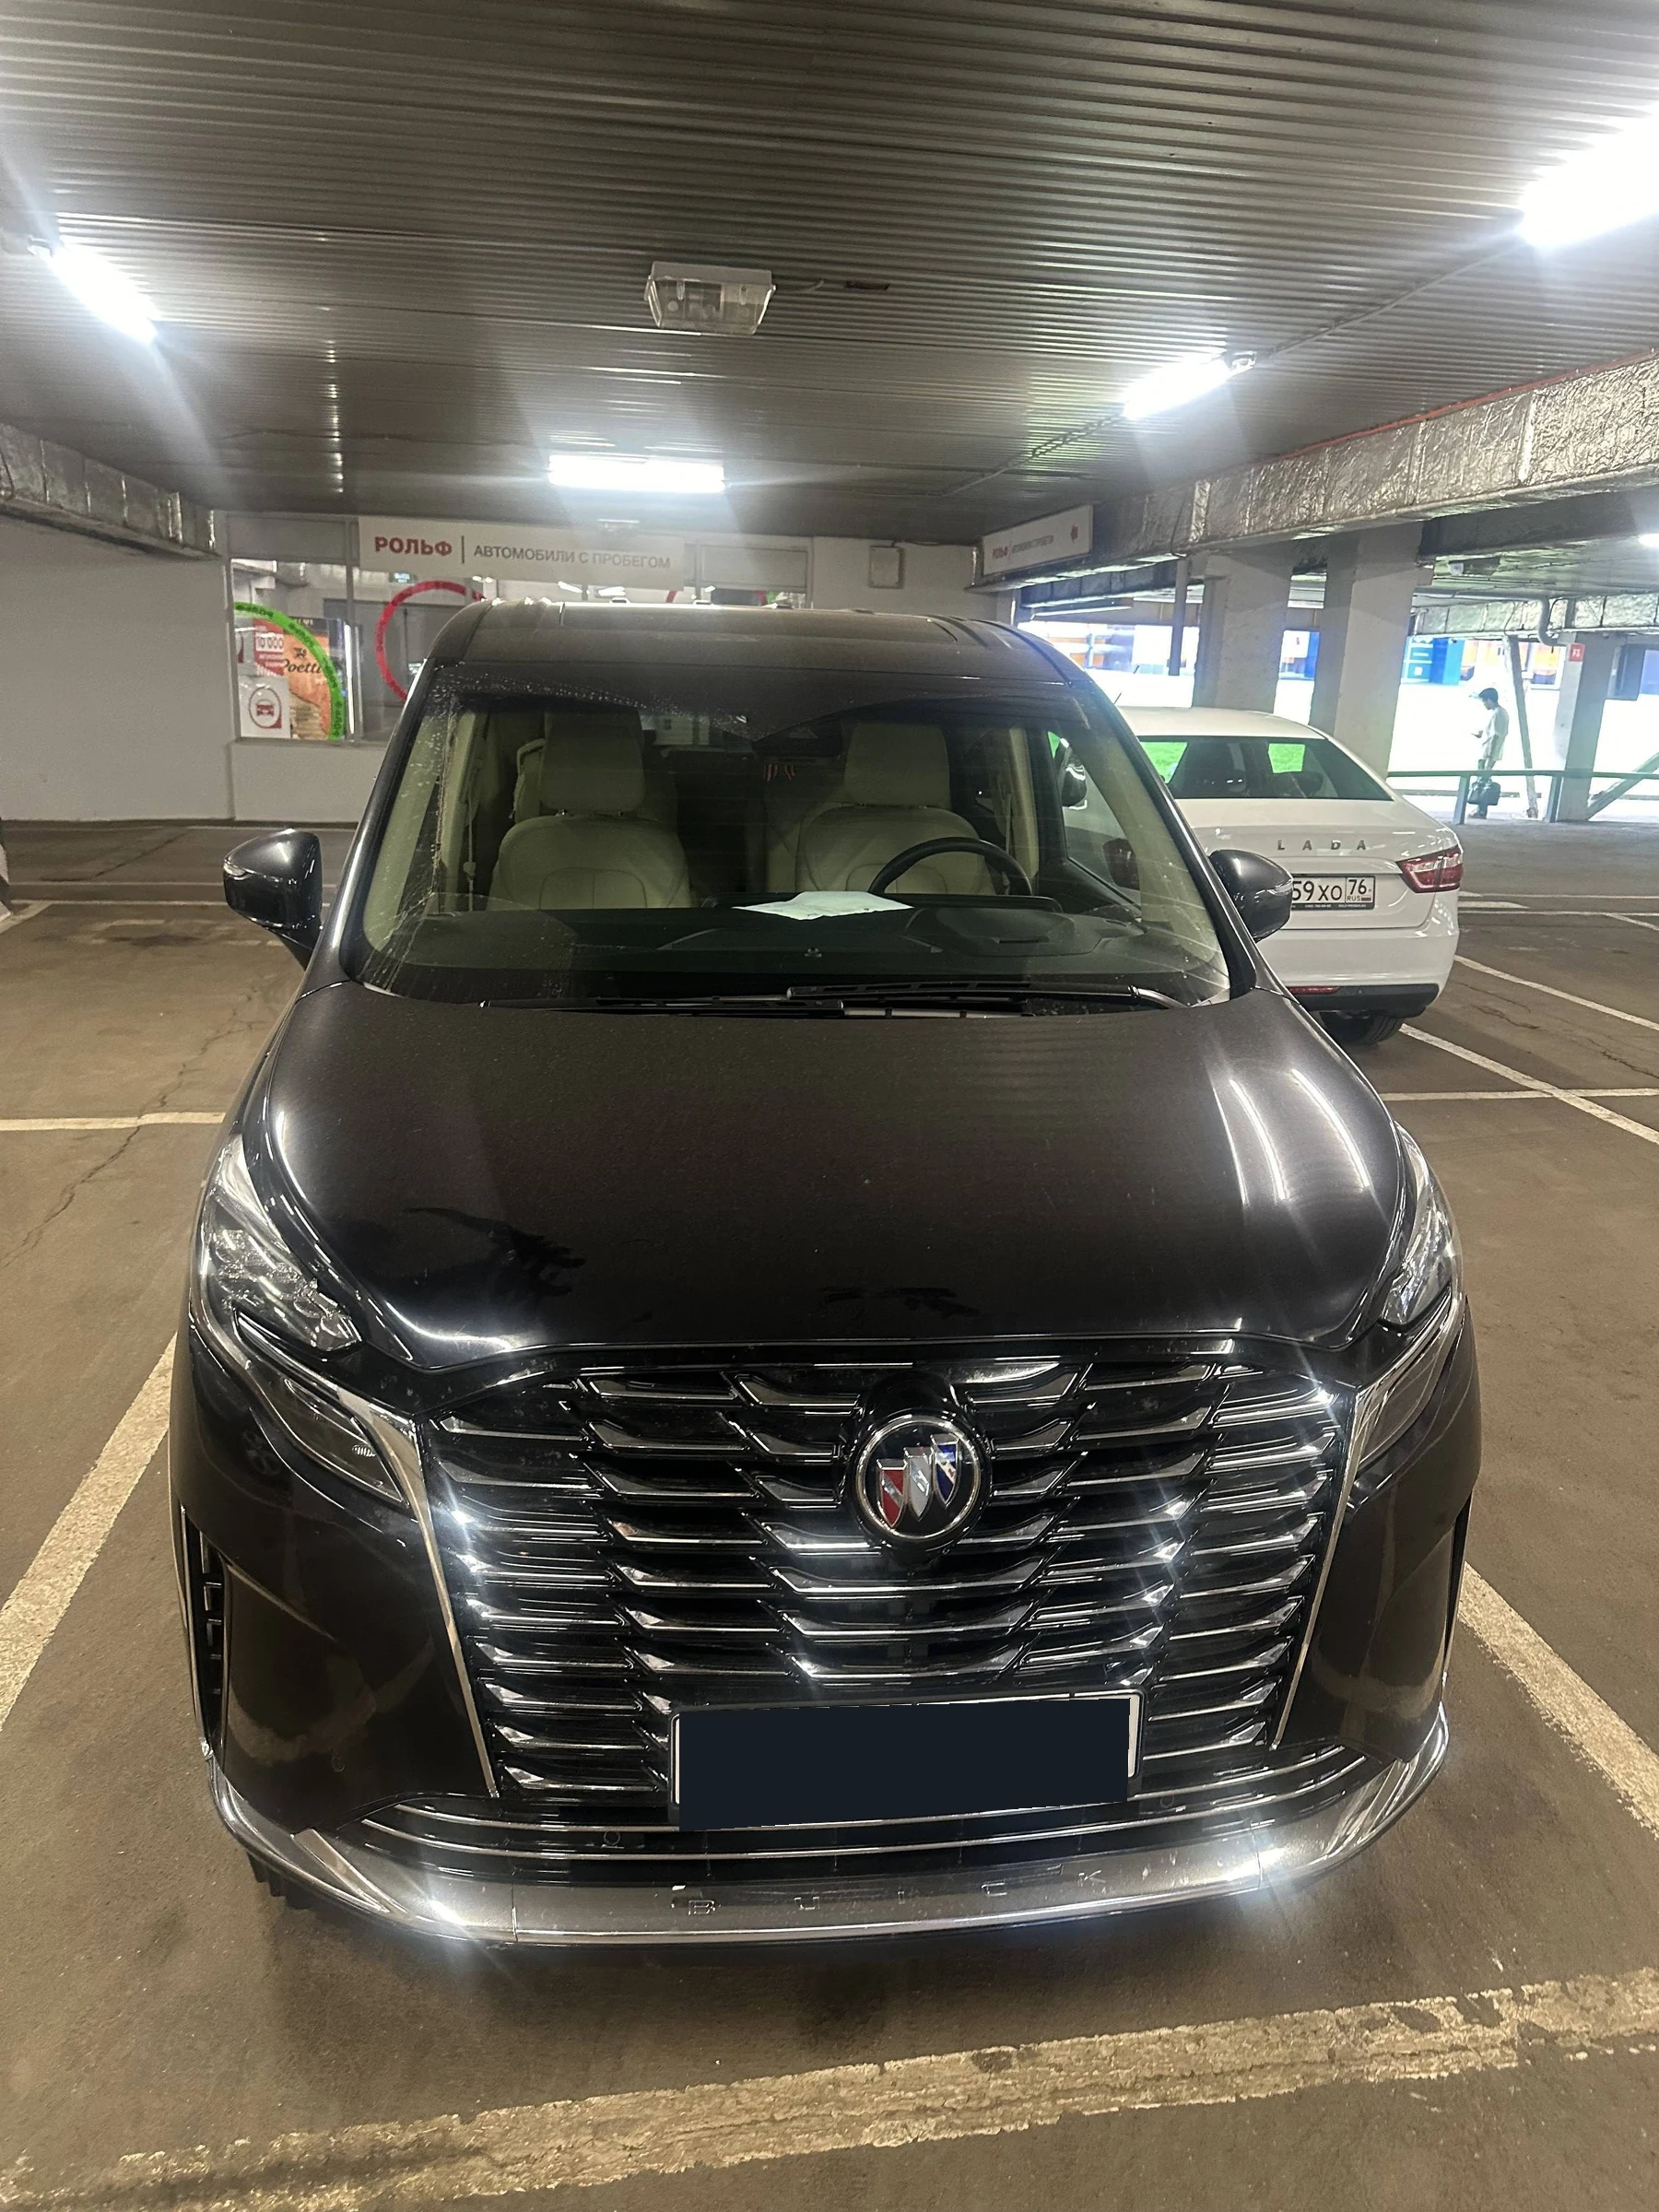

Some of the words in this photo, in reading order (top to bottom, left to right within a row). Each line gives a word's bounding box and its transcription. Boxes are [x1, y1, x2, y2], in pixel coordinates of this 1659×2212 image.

[374, 536, 453, 557] РОЛЬФ
[474, 545, 576, 564] АВТОМОБИЛИ
[579, 552, 588, 564] С
[593, 552, 672, 570] ПРОБЕГОМ
[1277, 840, 1366, 851] LADA
[1347, 878, 1367, 896] 76
[688, 1869, 1107, 1916] BUICK
